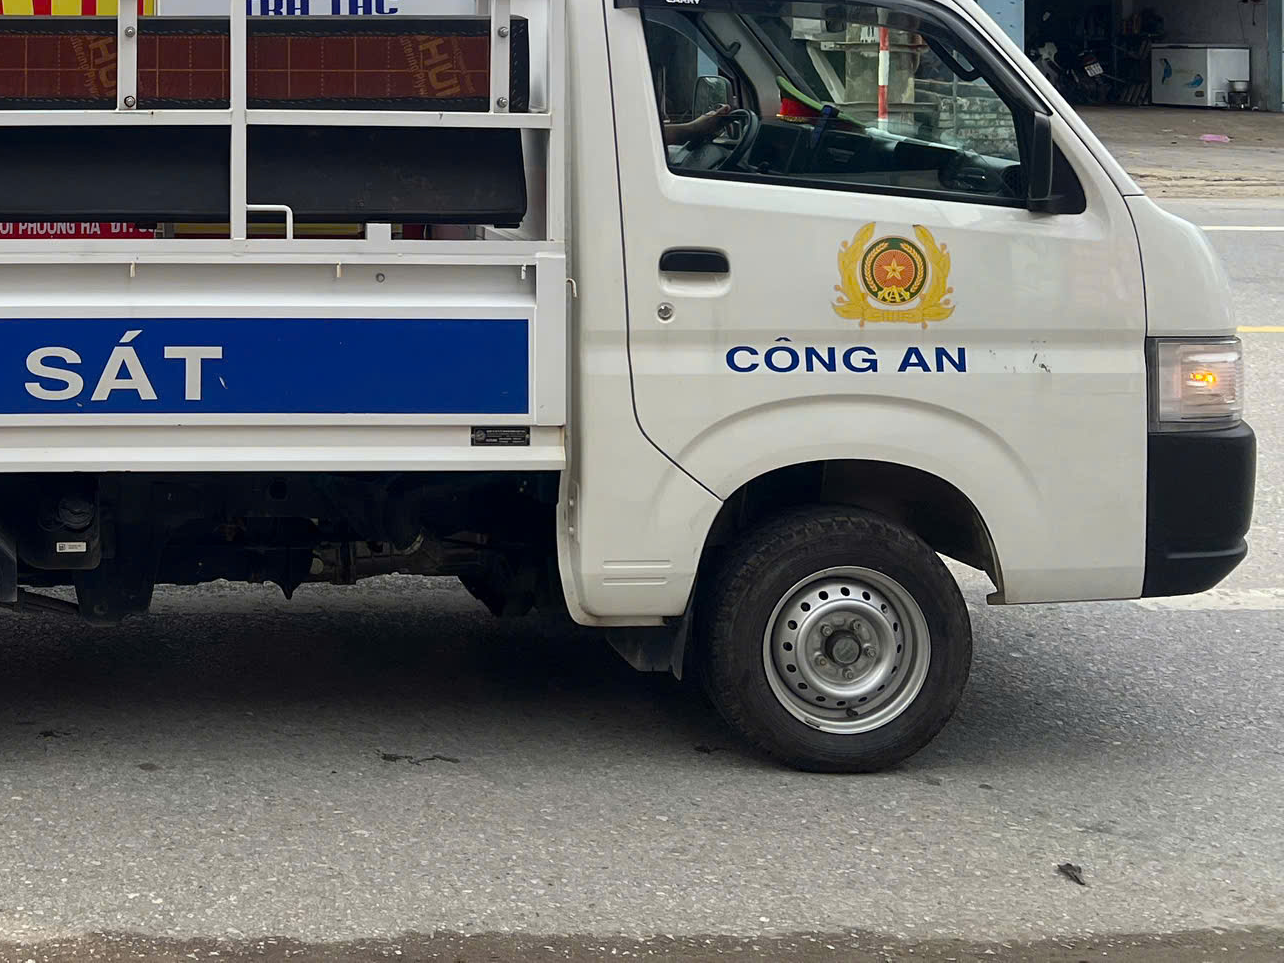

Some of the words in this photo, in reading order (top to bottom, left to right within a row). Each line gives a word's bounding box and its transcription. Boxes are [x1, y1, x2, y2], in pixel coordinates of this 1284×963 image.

[23, 328, 223, 404] SÁT
[725, 336, 879, 373] CÔNG
[897, 345, 968, 373] AN
